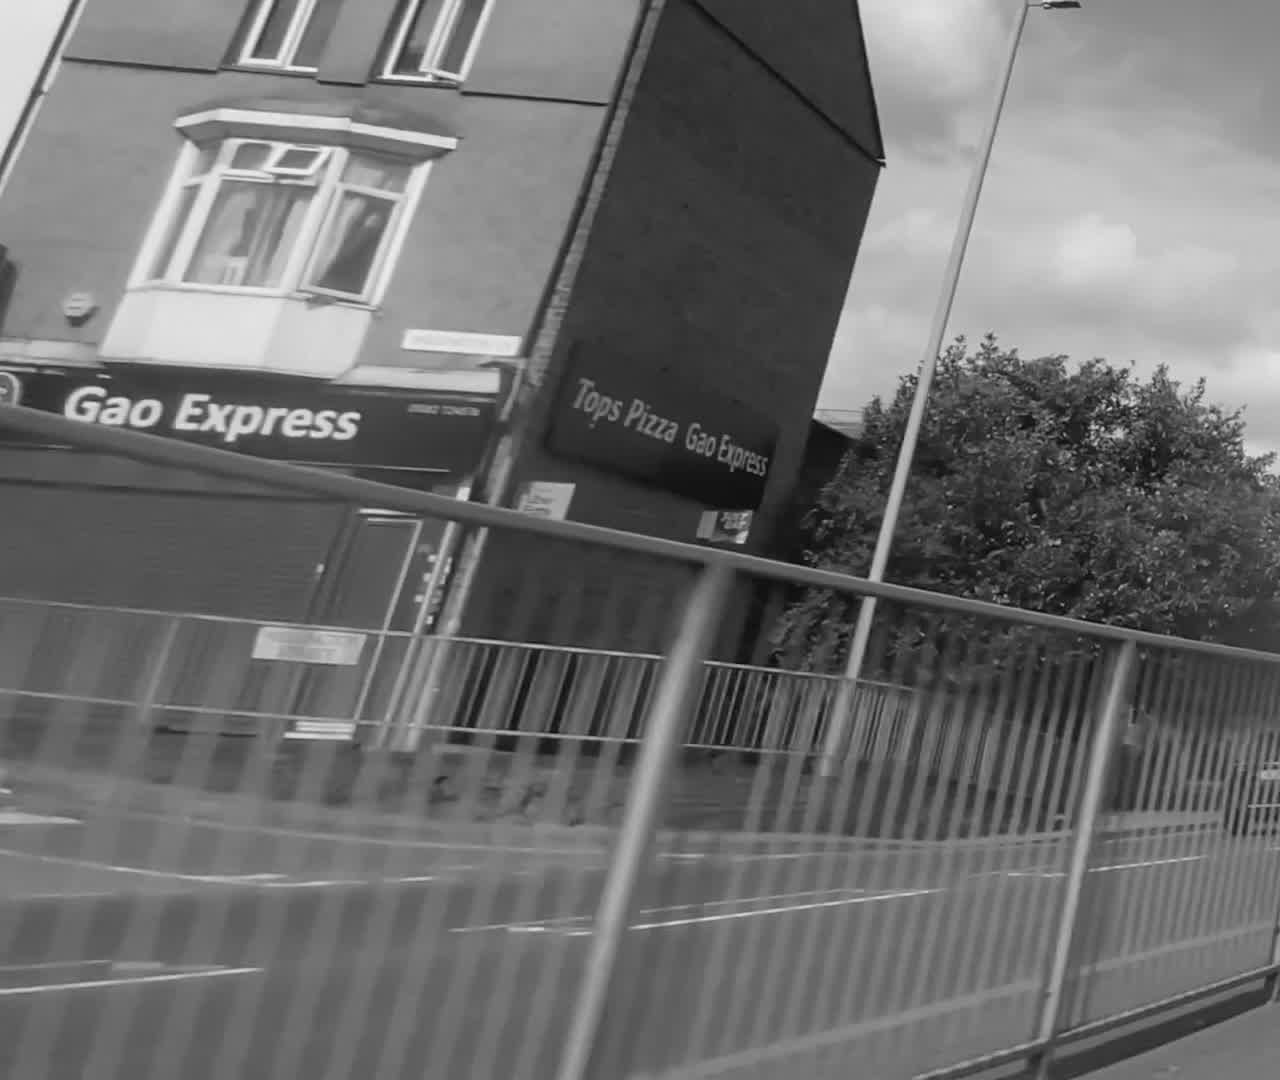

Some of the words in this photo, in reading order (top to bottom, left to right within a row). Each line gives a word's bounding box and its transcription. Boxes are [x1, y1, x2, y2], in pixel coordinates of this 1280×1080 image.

[63, 385, 163, 428] Gao
[174, 393, 363, 442] Express
[572, 377, 624, 429] Tops
[623, 398, 680, 443] Pizza
[685, 423, 717, 458] Gao
[717, 433, 769, 477] Express
